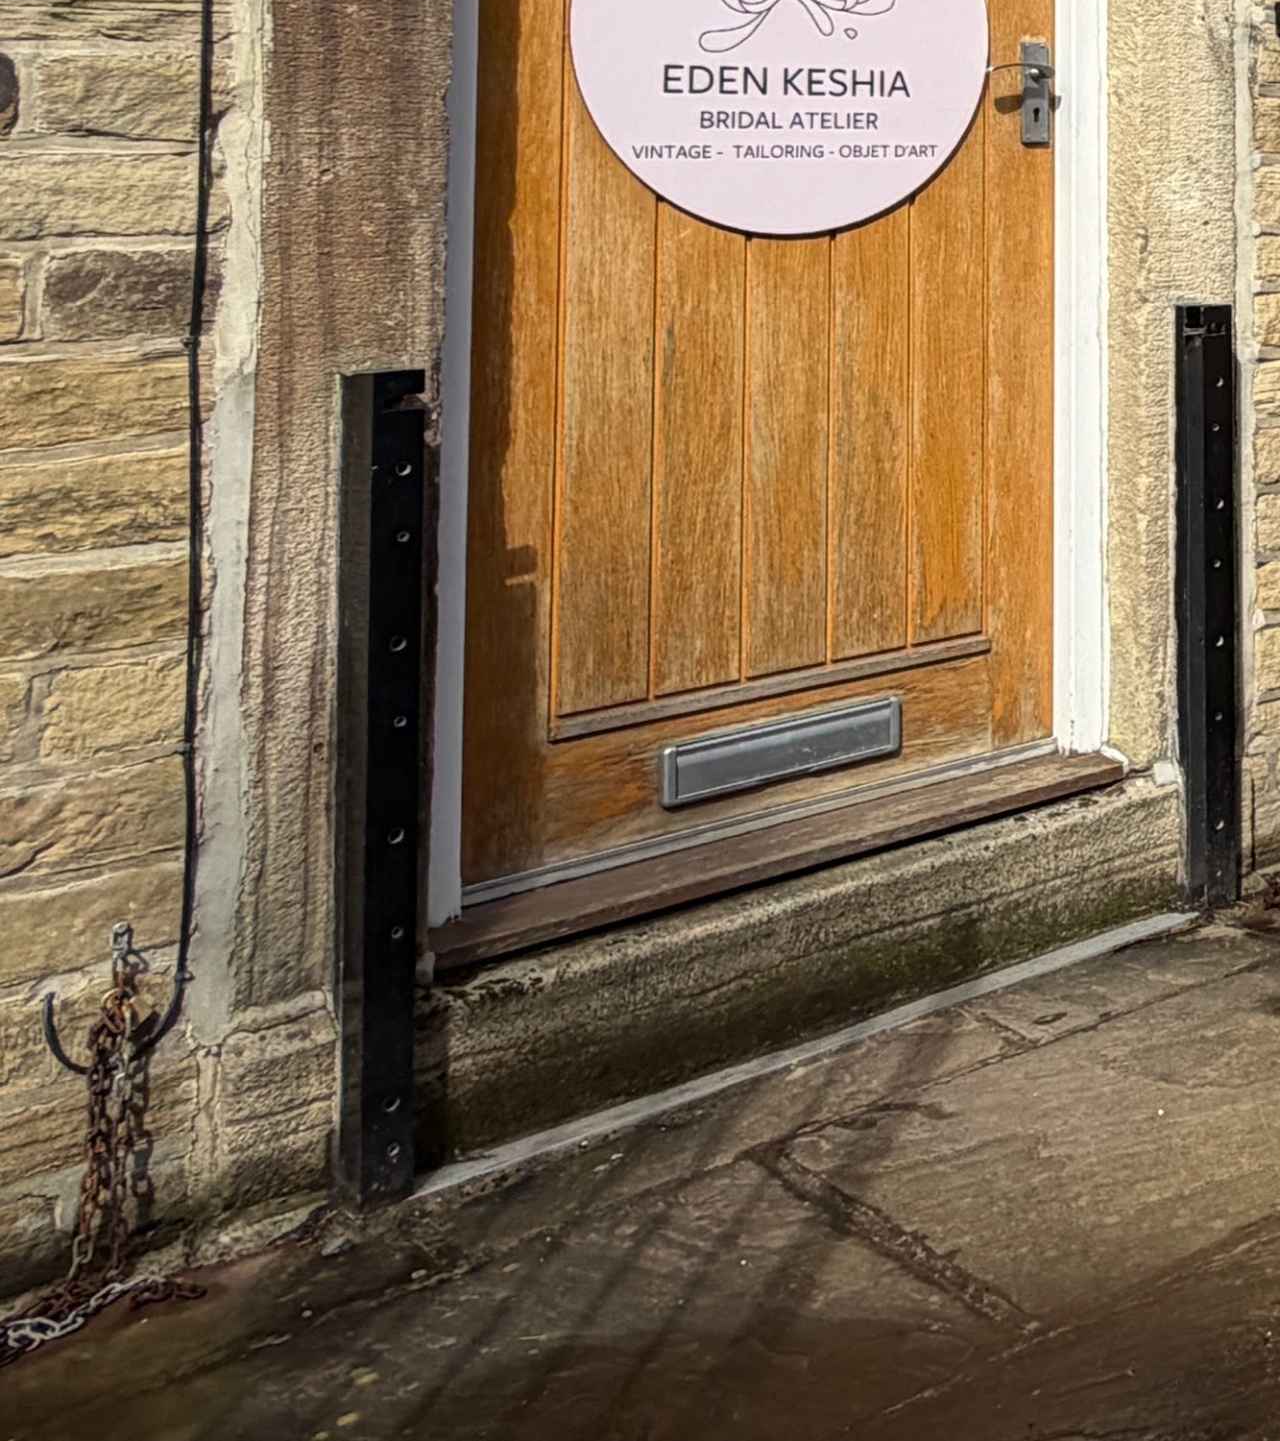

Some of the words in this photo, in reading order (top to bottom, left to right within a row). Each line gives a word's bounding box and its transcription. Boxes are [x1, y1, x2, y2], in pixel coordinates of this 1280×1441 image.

[663, 64, 768, 95] EDEN
[783, 67, 911, 98] KESHIA
[699, 110, 782, 129] BRIDAL
[789, 111, 879, 130] ATELIER
[632, 144, 712, 159] VINTAGE
[733, 144, 824, 159] TAILORING
[839, 144, 890, 158] OBJET
[894, 144, 938, 158] D'ART
